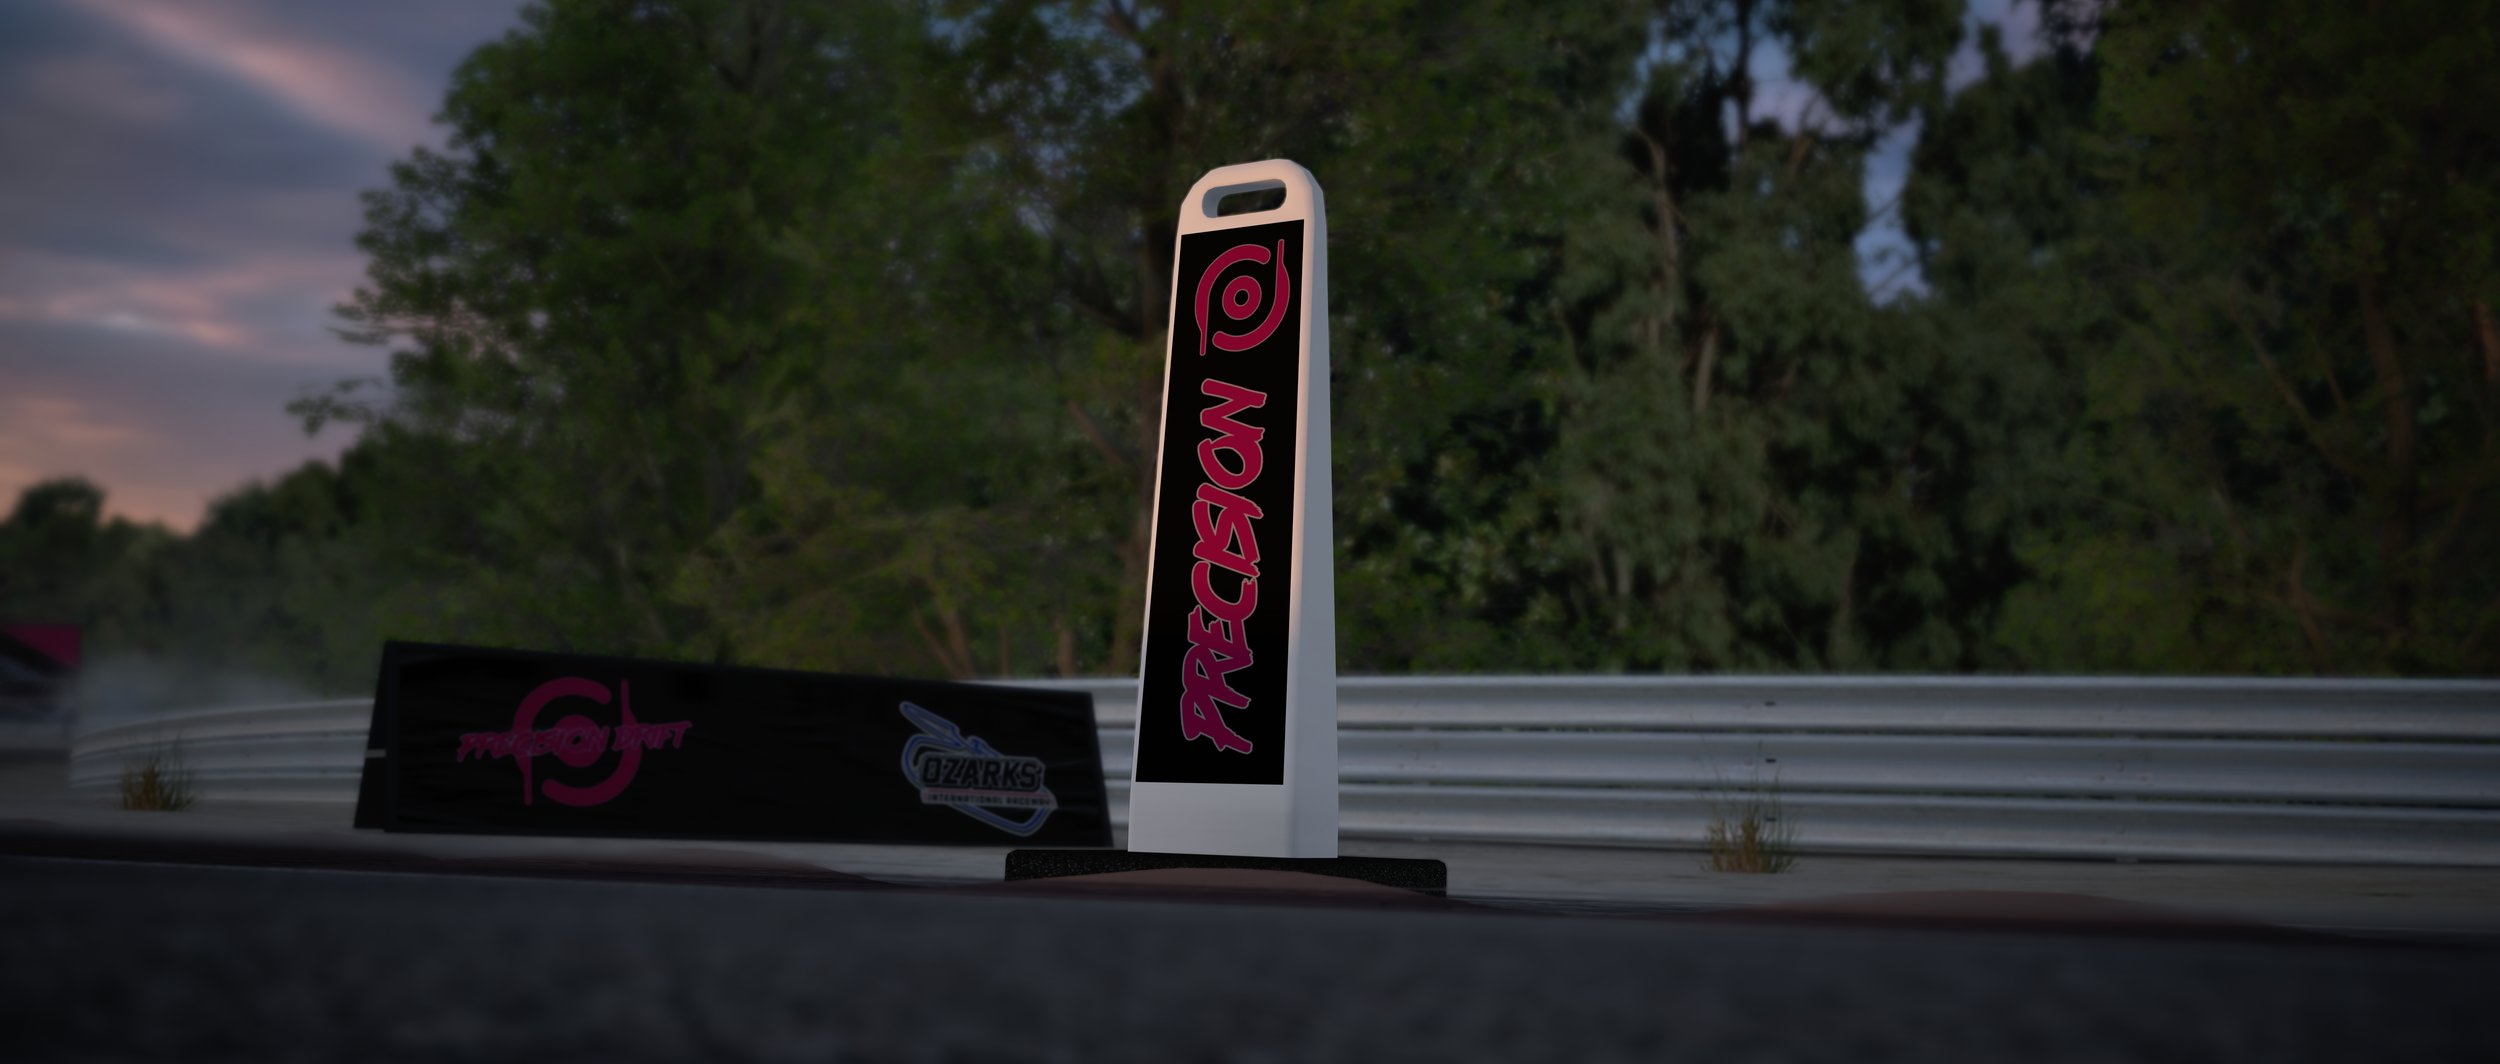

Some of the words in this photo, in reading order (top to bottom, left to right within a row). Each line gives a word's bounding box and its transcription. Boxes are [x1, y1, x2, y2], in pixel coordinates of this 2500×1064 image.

[1180, 377, 1267, 755] PRECISION
[457, 725, 610, 763] PRECISION
[611, 720, 693, 752] DRIFT
[923, 757, 1040, 790] OZARKS
